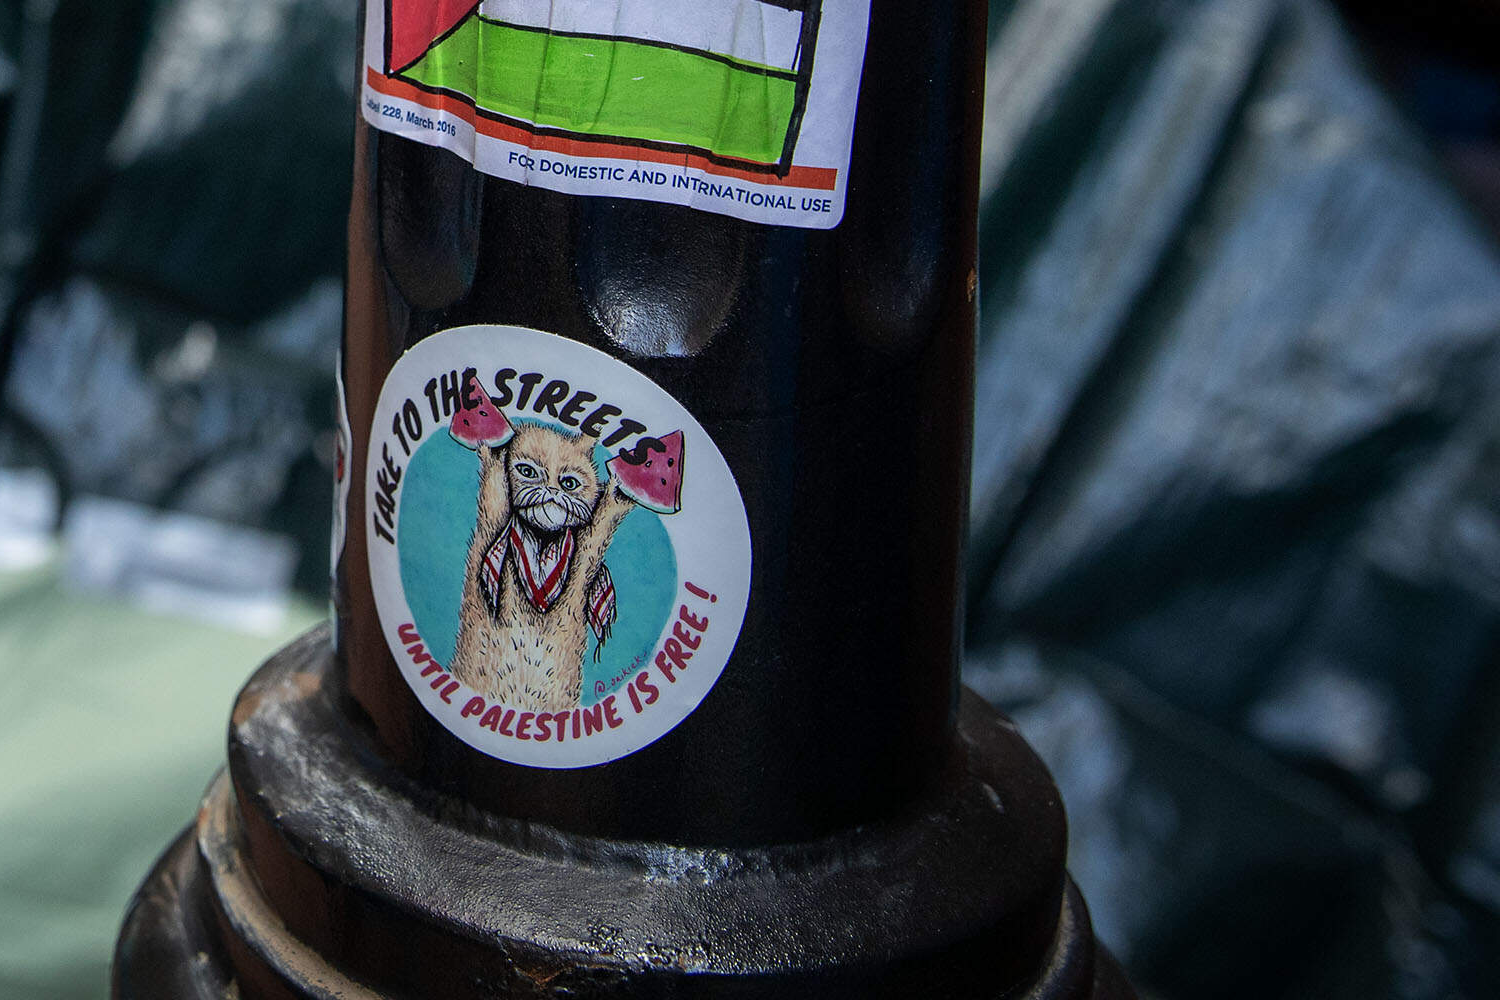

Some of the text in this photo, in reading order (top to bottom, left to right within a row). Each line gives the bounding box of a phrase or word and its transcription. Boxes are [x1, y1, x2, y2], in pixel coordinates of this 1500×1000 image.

[382, 104, 403, 122] 228,
[405, 110, 434, 131] March
[436, 120, 457, 137] 2016
[508, 151, 832, 213] FOR DOMESTIC AND INTRNATIONAL USE
[372, 366, 667, 546] TAKE TO THE STREETS
[397, 622, 461, 706] UNTIL
[460, 694, 624, 743] PALESTINE
[626, 671, 661, 715] IS
[654, 603, 709, 684] FREE
